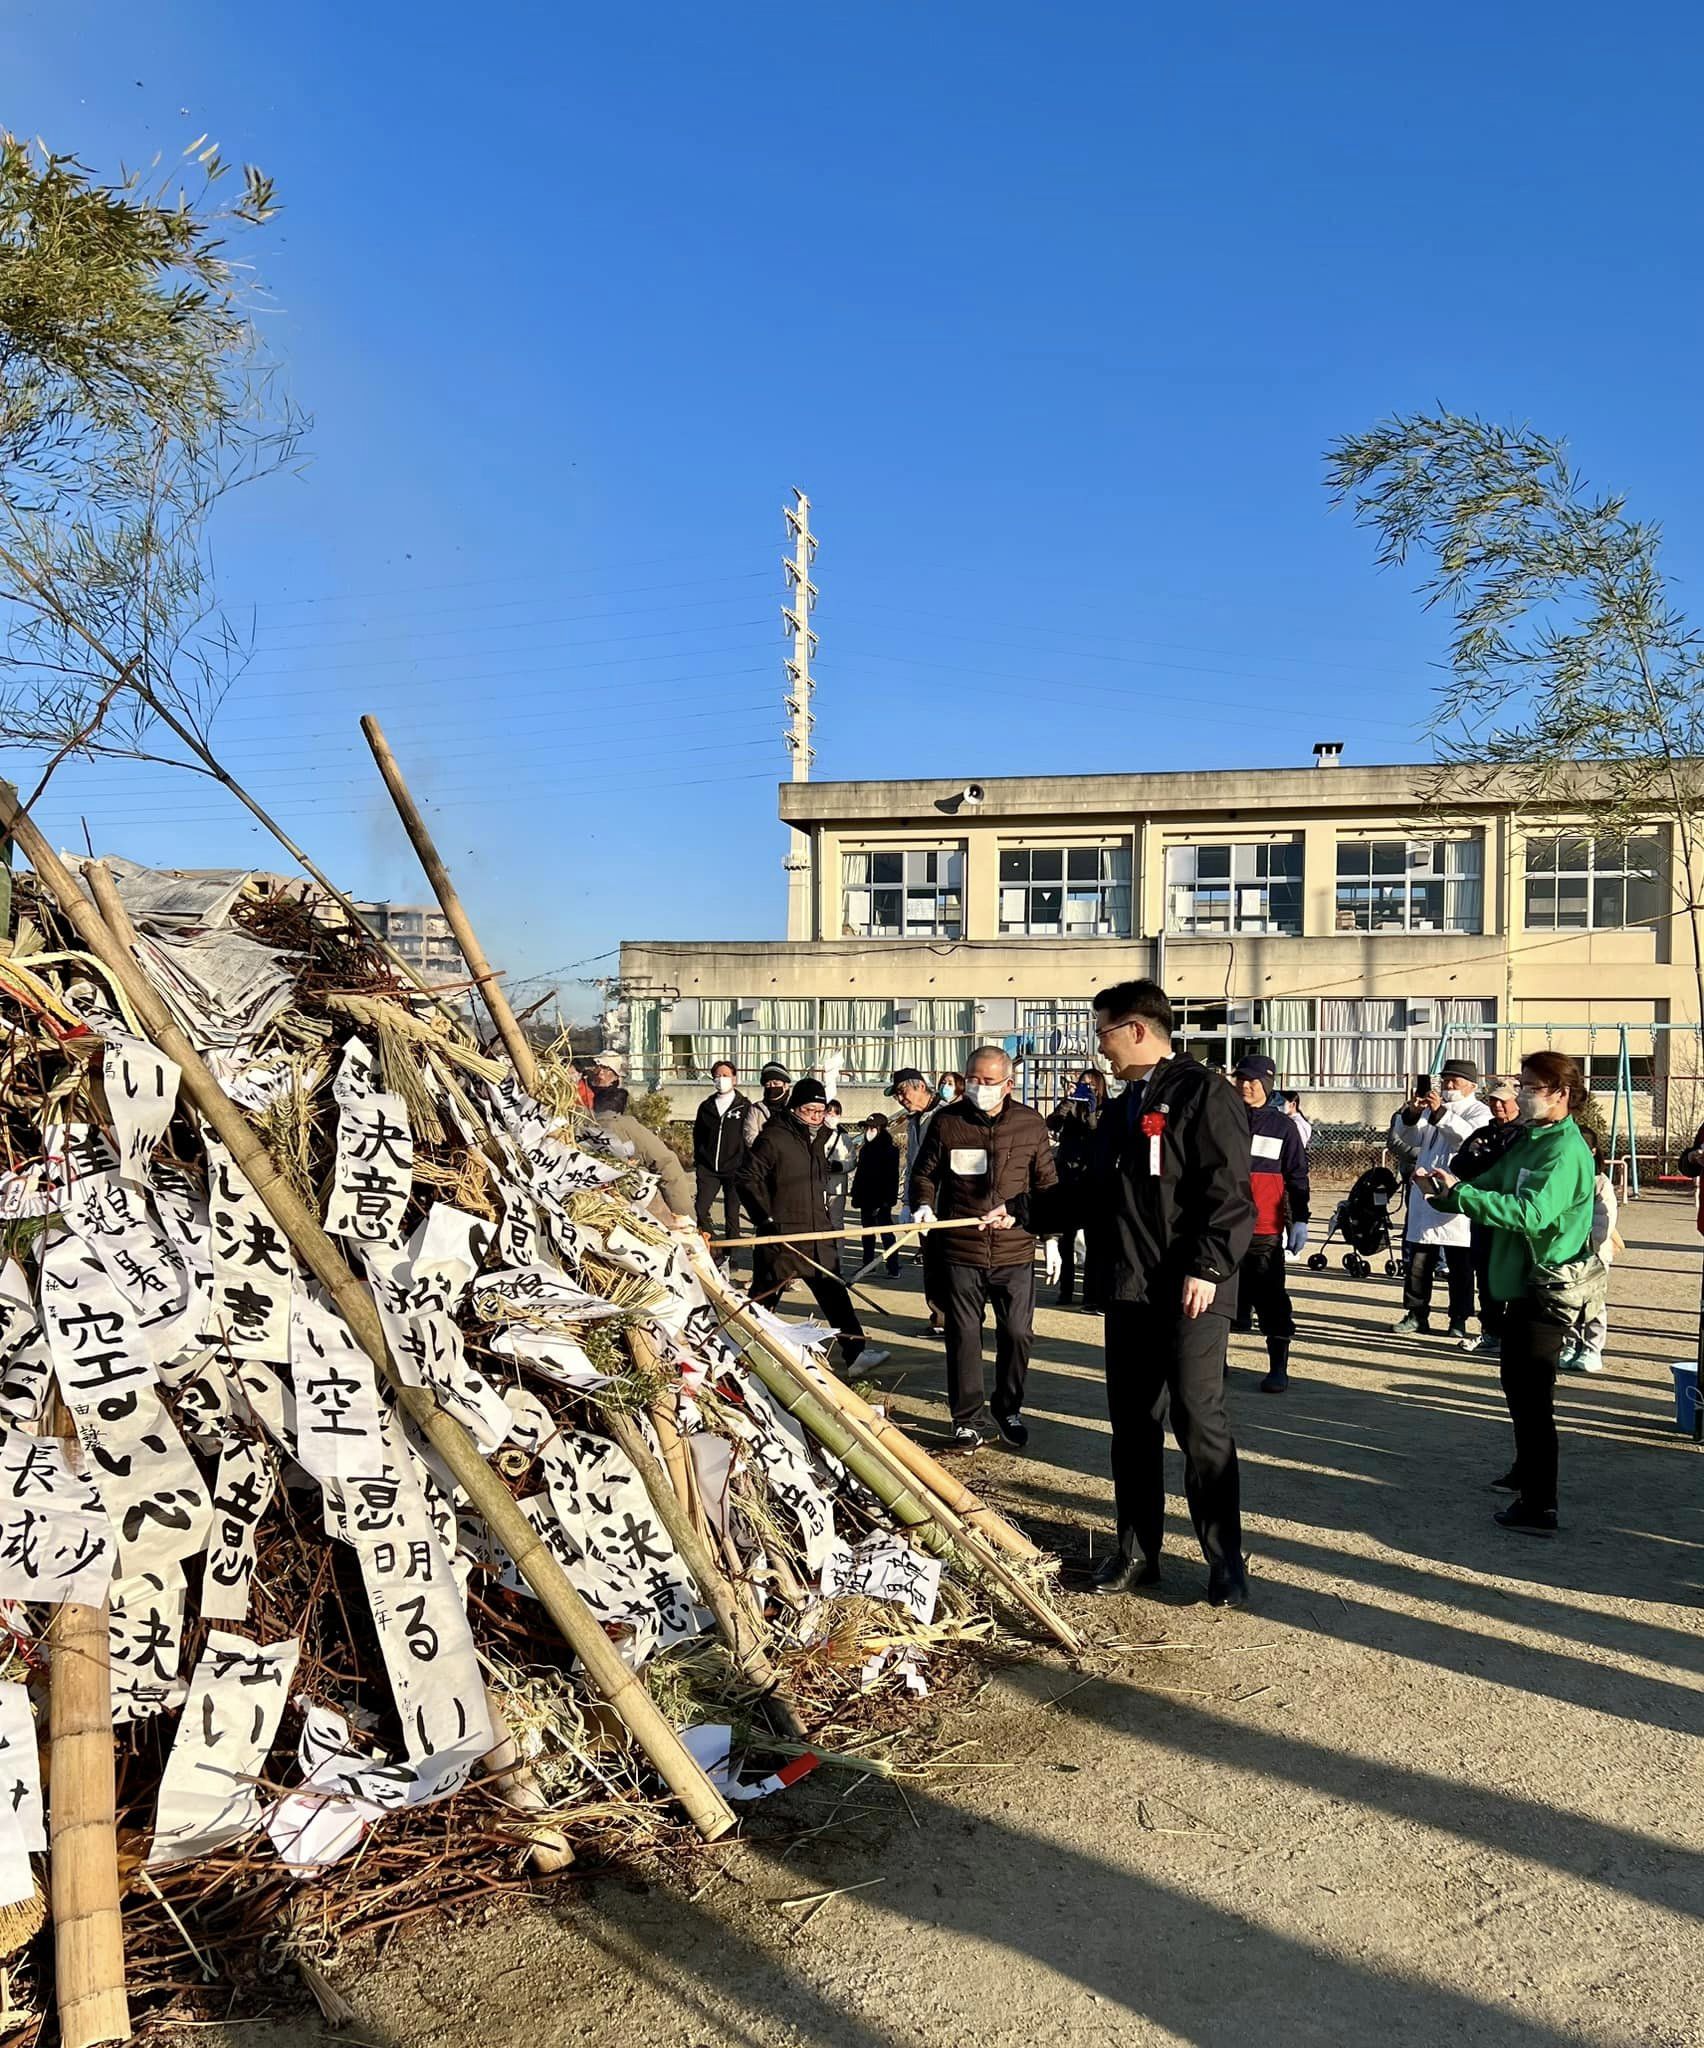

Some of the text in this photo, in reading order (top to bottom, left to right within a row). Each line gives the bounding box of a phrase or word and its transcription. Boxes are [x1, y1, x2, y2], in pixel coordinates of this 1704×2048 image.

[338, 1109, 412, 1241] 決意
[305, 1327, 369, 1437] い空
[373, 1540, 467, 1756] 明るい
